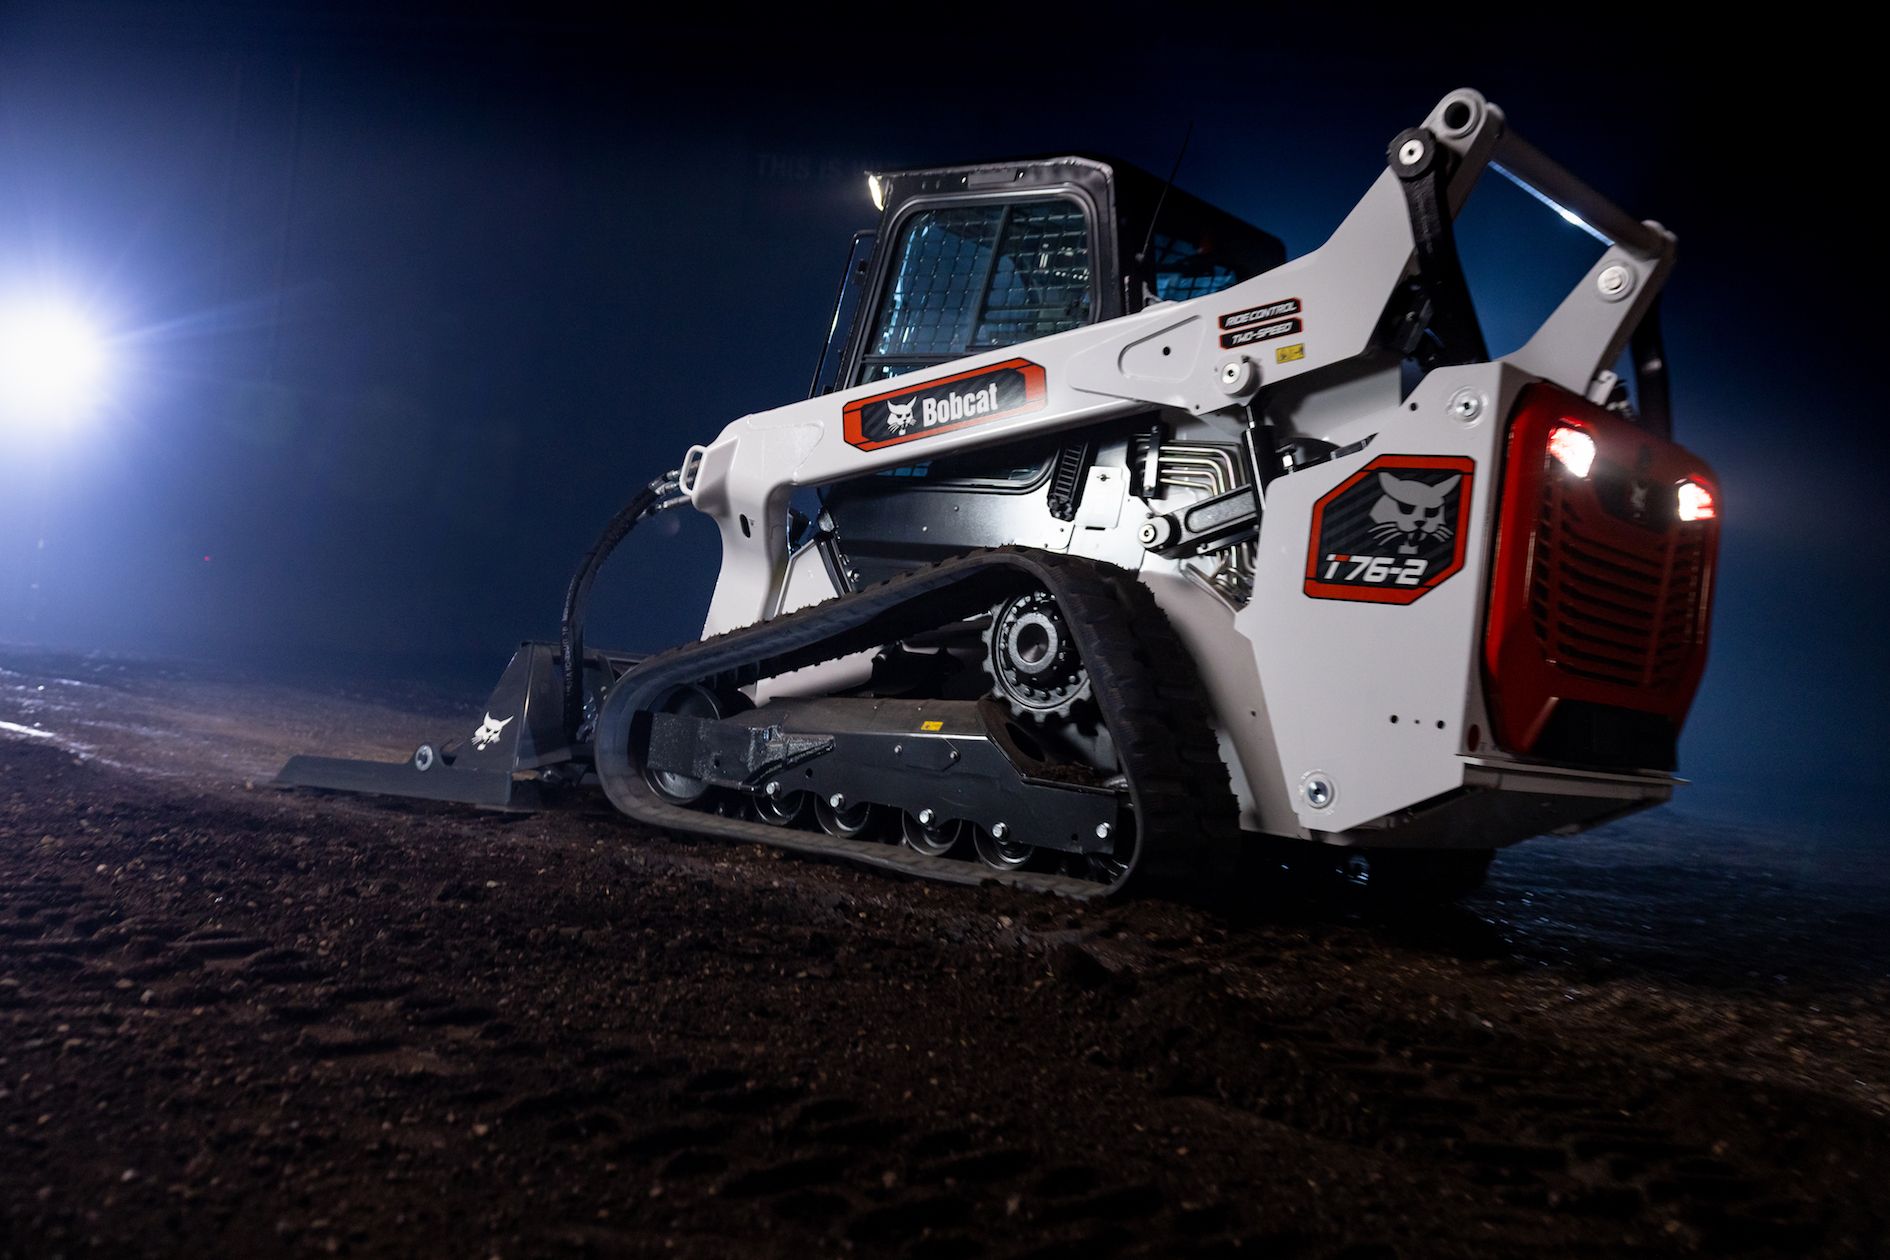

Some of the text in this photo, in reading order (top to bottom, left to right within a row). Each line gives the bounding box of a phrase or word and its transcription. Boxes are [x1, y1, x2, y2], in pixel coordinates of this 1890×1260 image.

[1225, 301, 1298, 327] RIDE CONTROL
[1231, 321, 1293, 345] TWO-SPEED
[922, 383, 998, 428] Bobcat
[1323, 553, 1428, 585] T76-2
